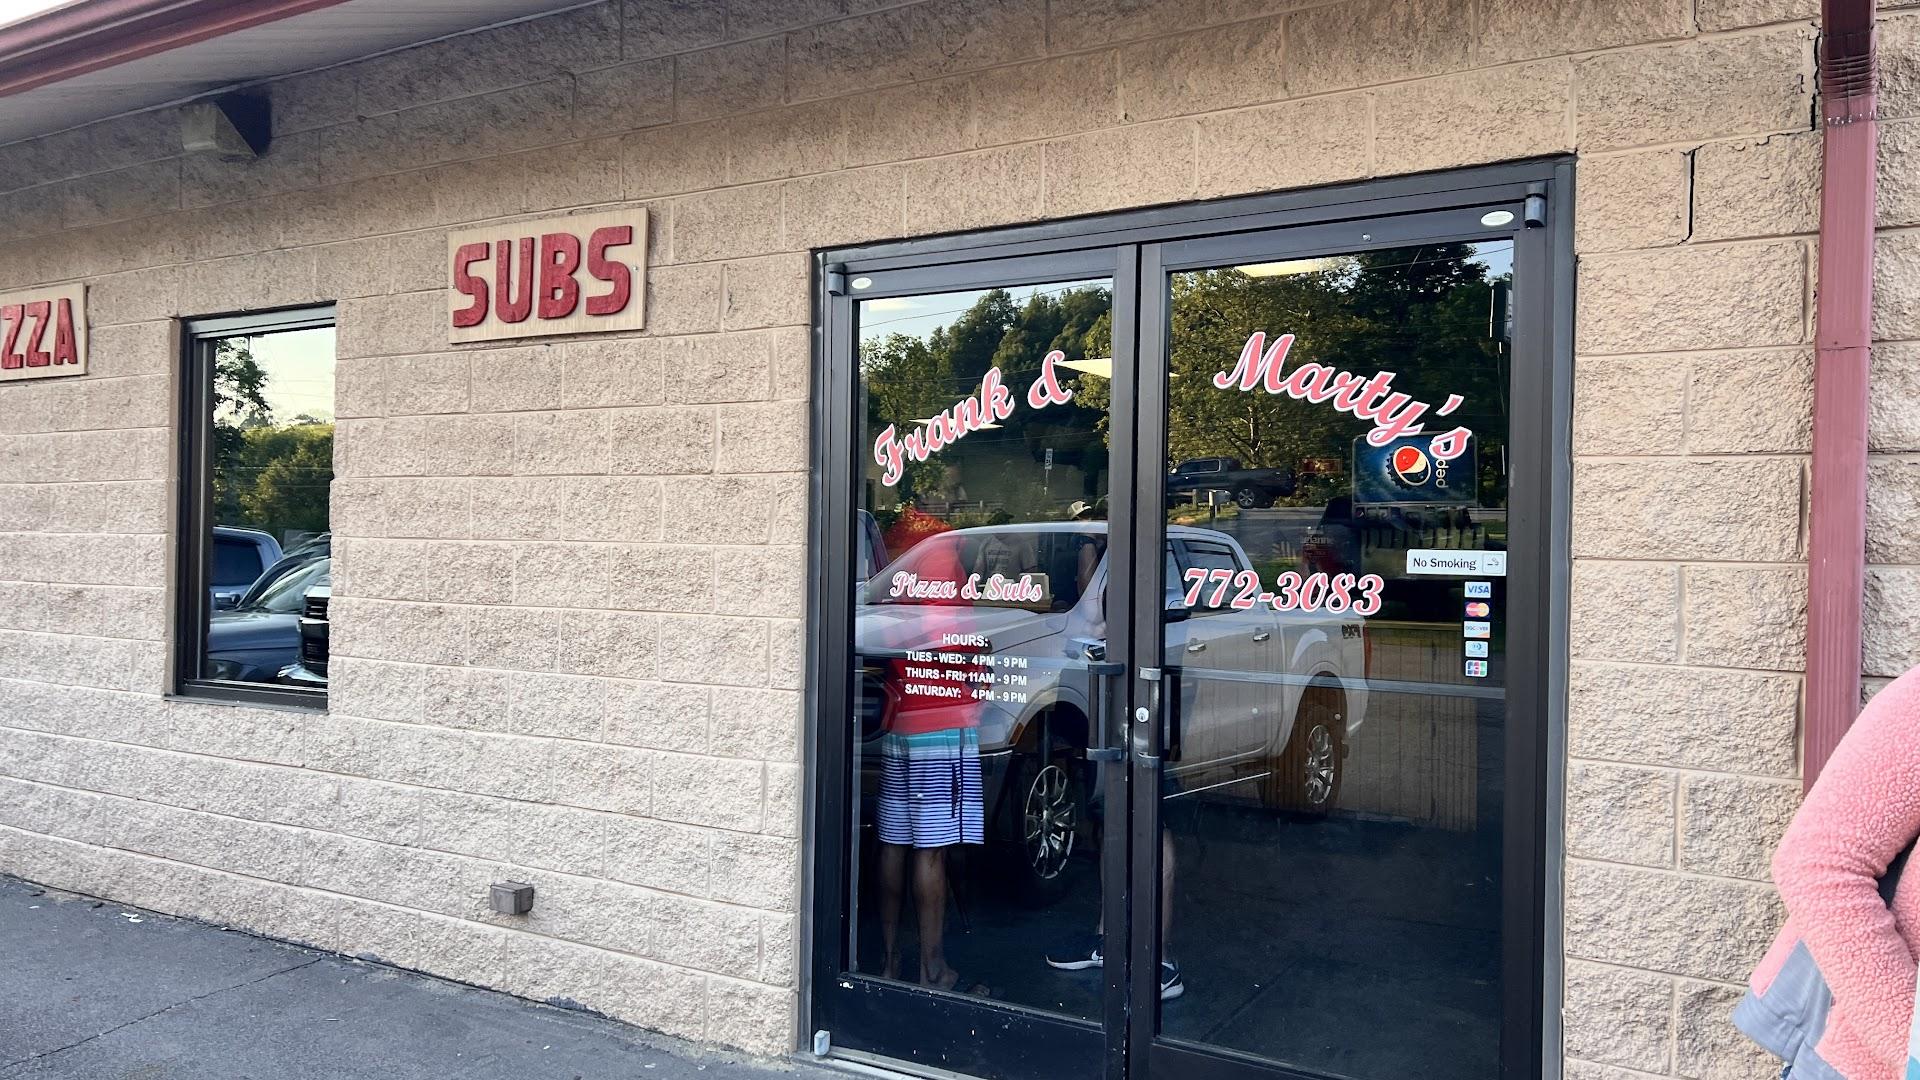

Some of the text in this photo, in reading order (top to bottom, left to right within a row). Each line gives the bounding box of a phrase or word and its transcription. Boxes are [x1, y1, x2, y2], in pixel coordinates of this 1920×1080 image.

[453, 225, 632, 327] SUBS
[874, 331, 1472, 487] Frank & Marty's
[1413, 558, 1477, 570] No Smoking
[889, 571, 1043, 602] Pizza & Subs
[1184, 568, 1384, 616] 772-3083
[1468, 585, 1490, 594] VISA
[942, 633, 989, 647] HOURS:
[904, 684, 961, 698] SATURDAY:
